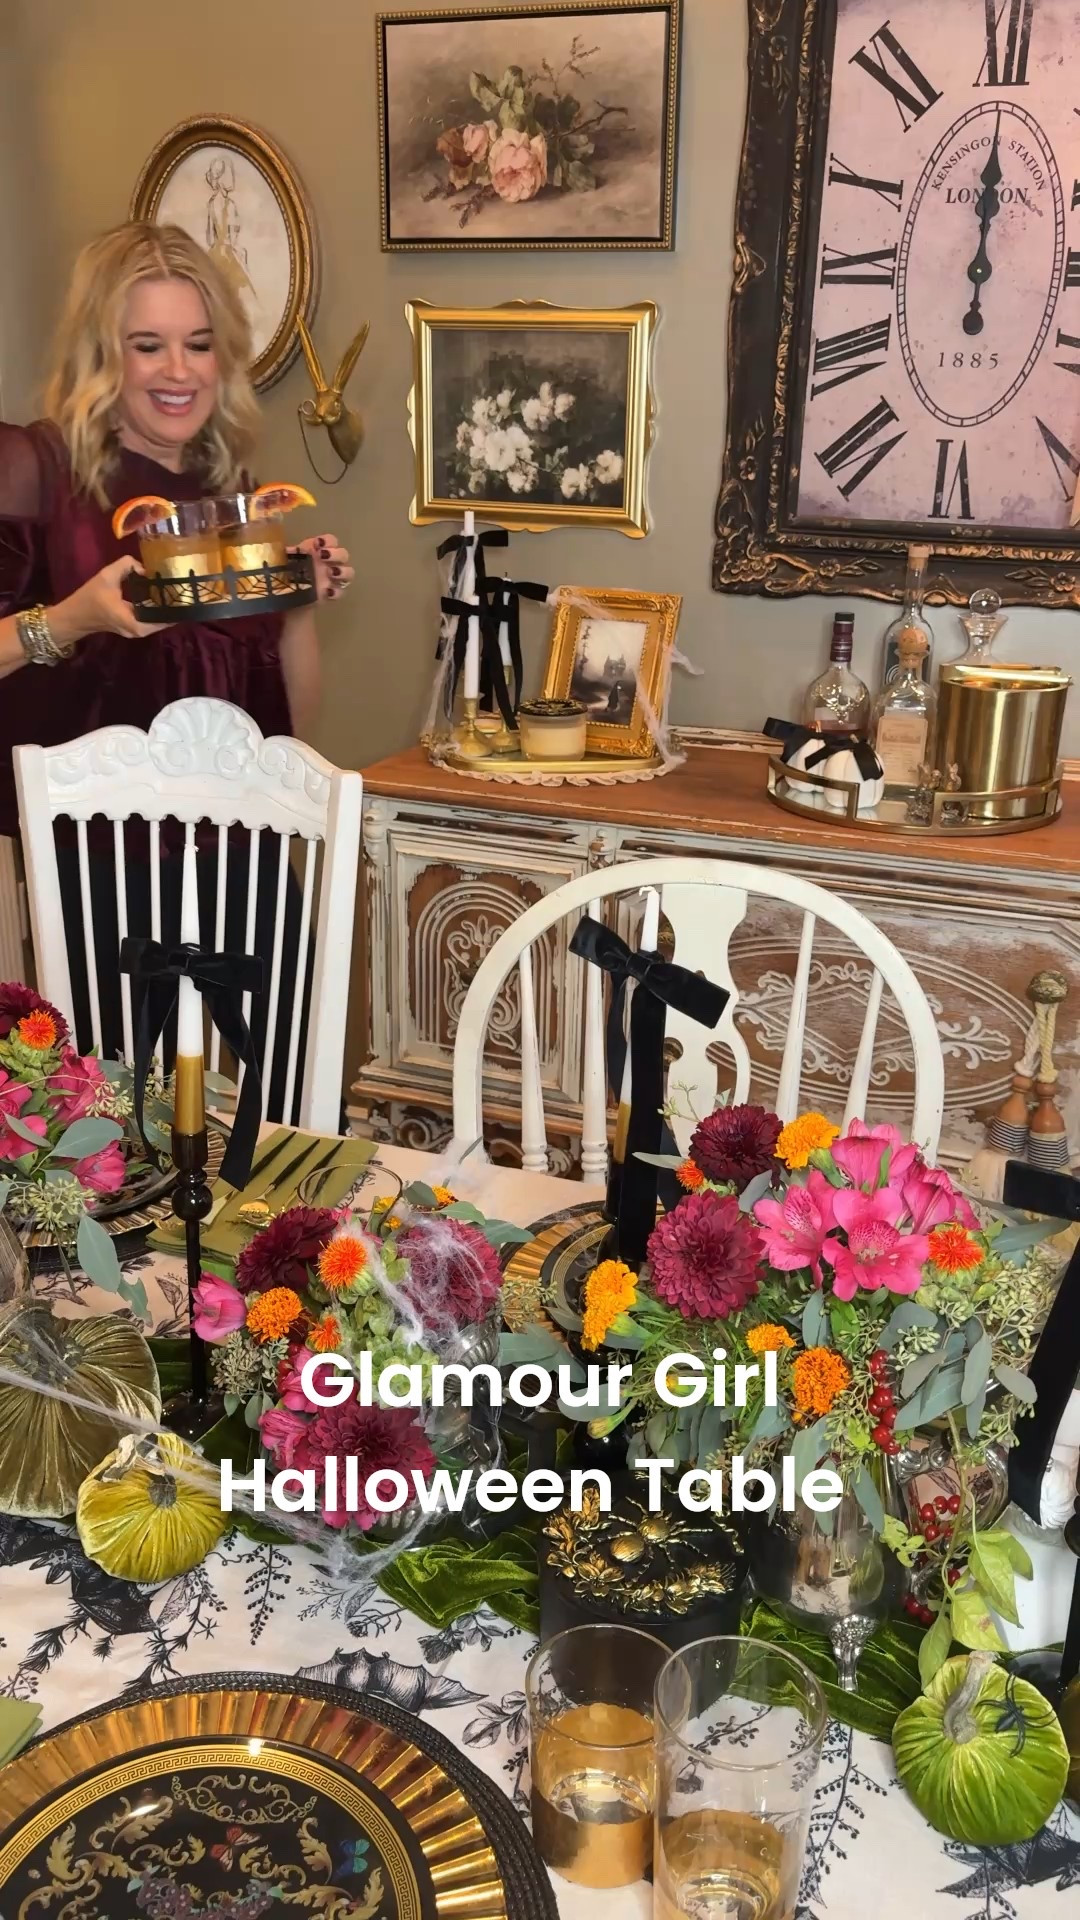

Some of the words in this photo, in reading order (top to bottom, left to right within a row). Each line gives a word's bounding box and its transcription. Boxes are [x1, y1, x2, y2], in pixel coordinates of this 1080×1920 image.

[972, 0, 1034, 87] XII
[848, 19, 944, 133] XI
[829, 152, 903, 212] X
[1008, 140, 1046, 191] STATION
[945, 188, 1029, 204] LONON
[938, 351, 1000, 370] 1885
[927, 439, 976, 520] VI
